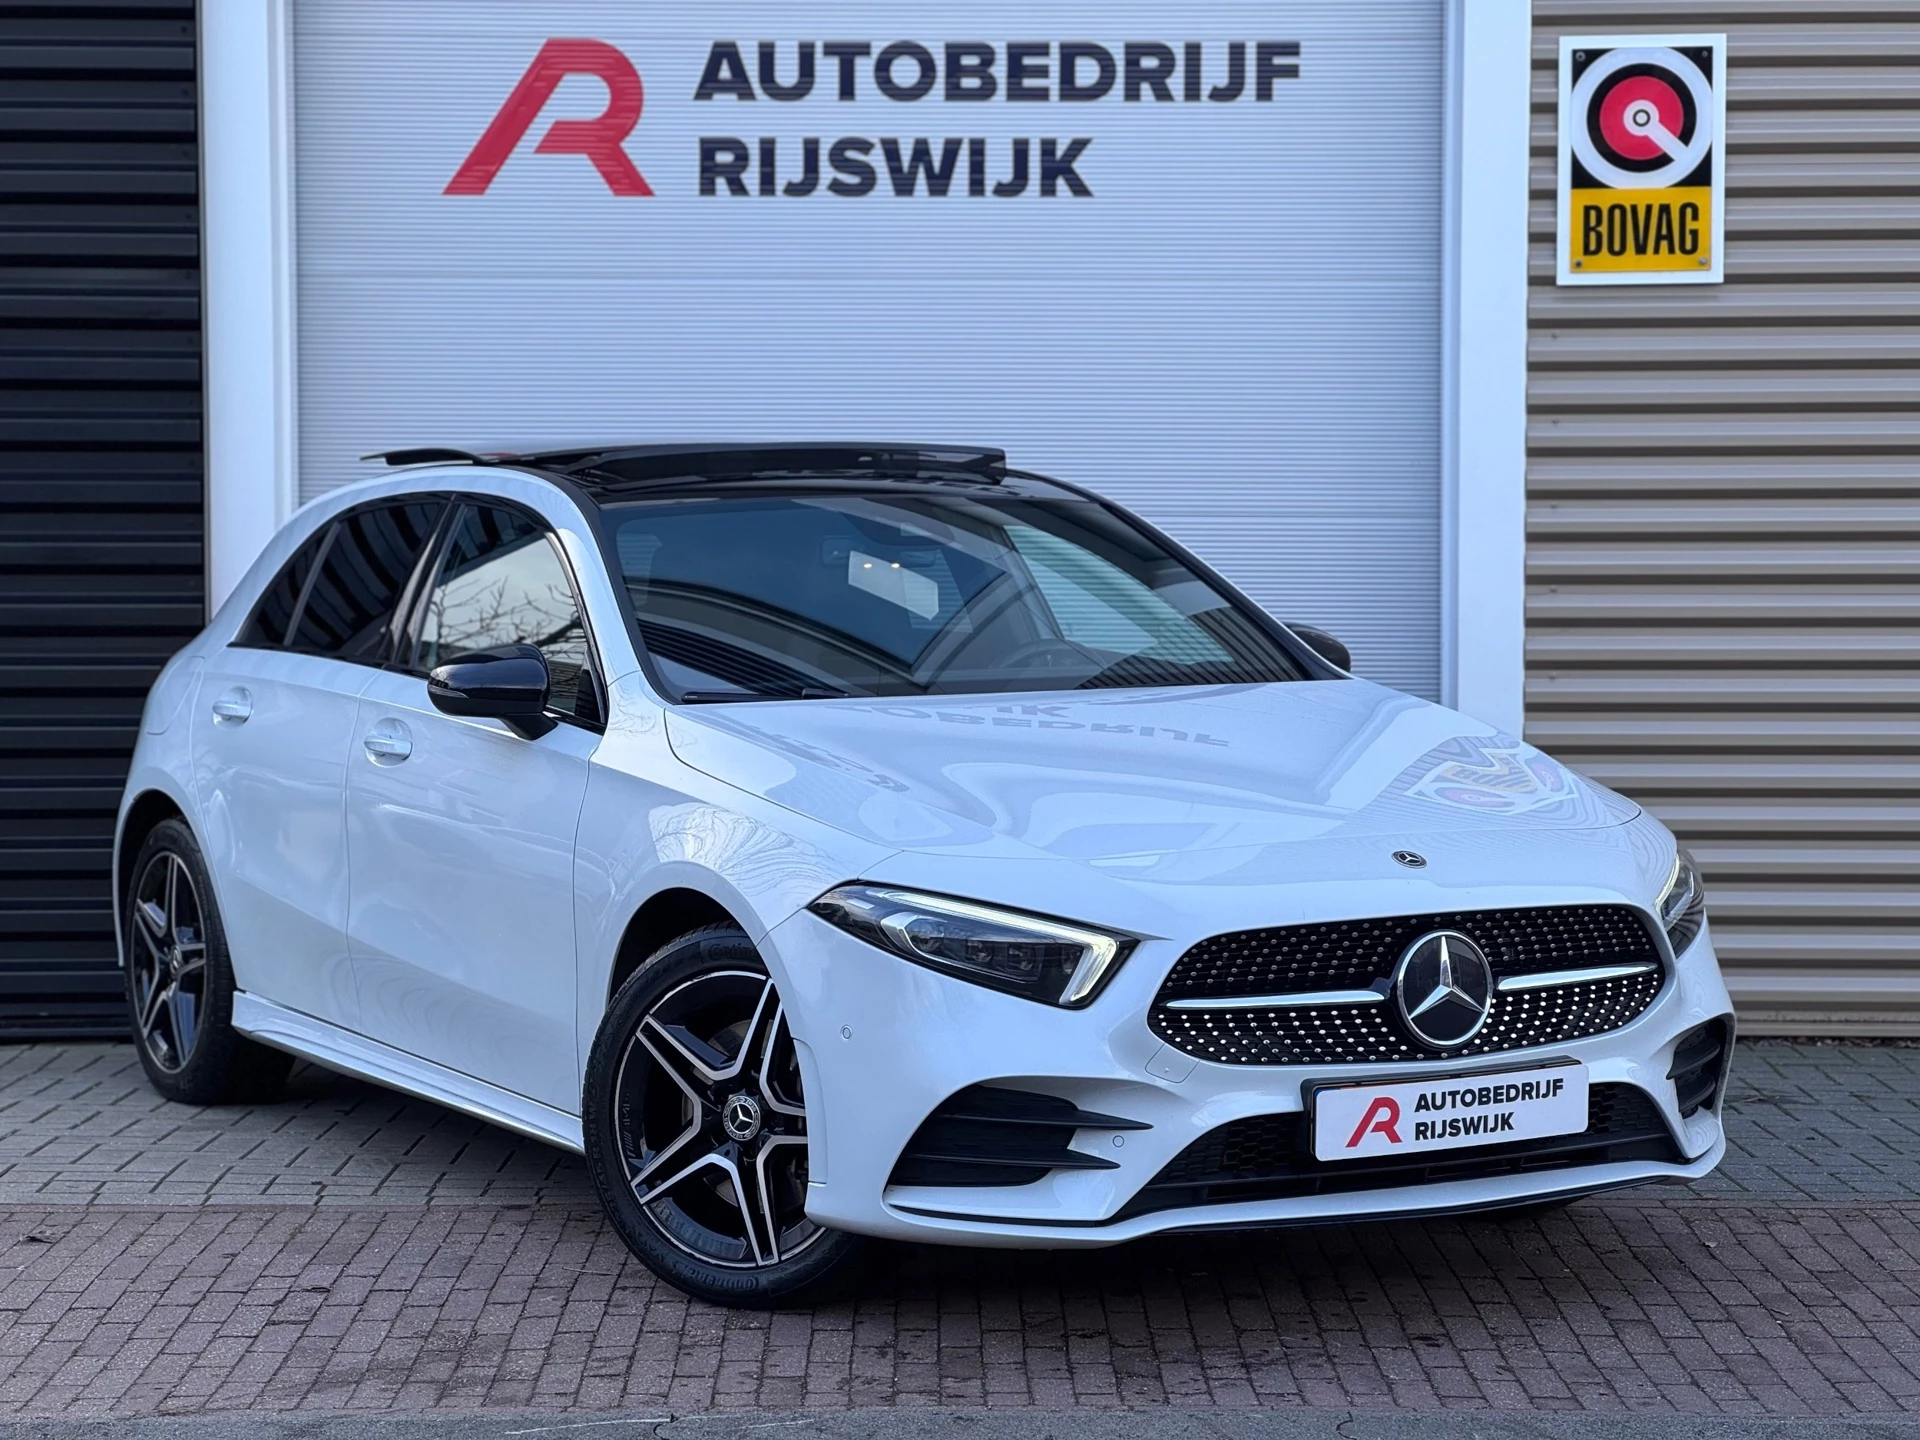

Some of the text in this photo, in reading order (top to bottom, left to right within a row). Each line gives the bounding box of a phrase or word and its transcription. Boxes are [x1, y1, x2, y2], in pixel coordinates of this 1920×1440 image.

[694, 41, 1301, 103] AUTOBEDRIJF
[699, 138, 1094, 198] RIJSWIJK
[1582, 202, 1700, 257] BOVAG
[1414, 1078, 1564, 1113] AUTOBEDRIJF
[1415, 1112, 1515, 1141] RIJSWIJK
